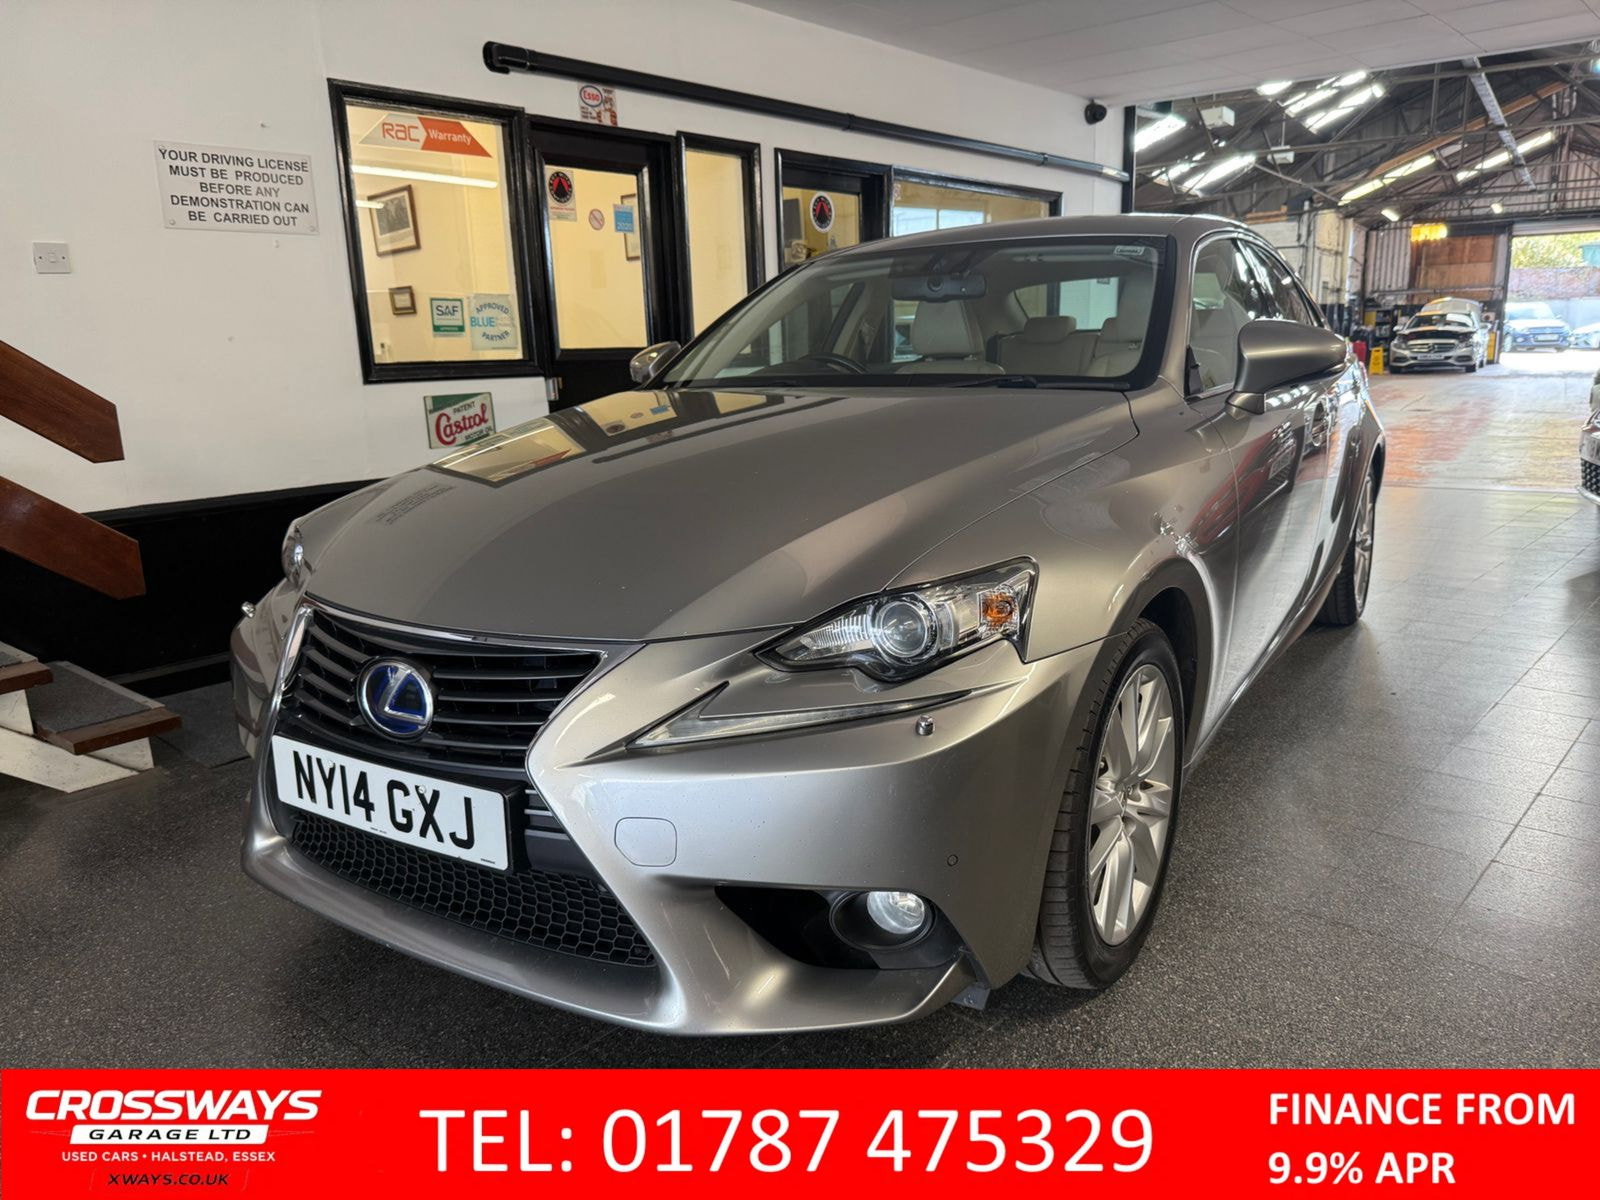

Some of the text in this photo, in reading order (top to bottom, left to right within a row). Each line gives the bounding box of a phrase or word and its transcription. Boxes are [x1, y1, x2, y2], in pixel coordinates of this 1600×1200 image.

[428, 128, 472, 145] Warranty
[158, 148, 309, 172] YOUR DRIVING LICENSE
[169, 165, 304, 186] MUST BE PRODUCED
[199, 182, 280, 198] BEFORE ANY
[170, 194, 309, 213] DEMONSTRATION CAN
[188, 211, 297, 226] BE CARRIED OUT
[435, 305, 459, 317] SAF
[475, 302, 510, 315] APPROVED
[470, 316, 496, 327] BLUE
[481, 330, 510, 342] PARTNER
[453, 400, 476, 414] PATENT
[435, 402, 489, 446] Castrol
[293, 750, 475, 850] NY14 GXJ
